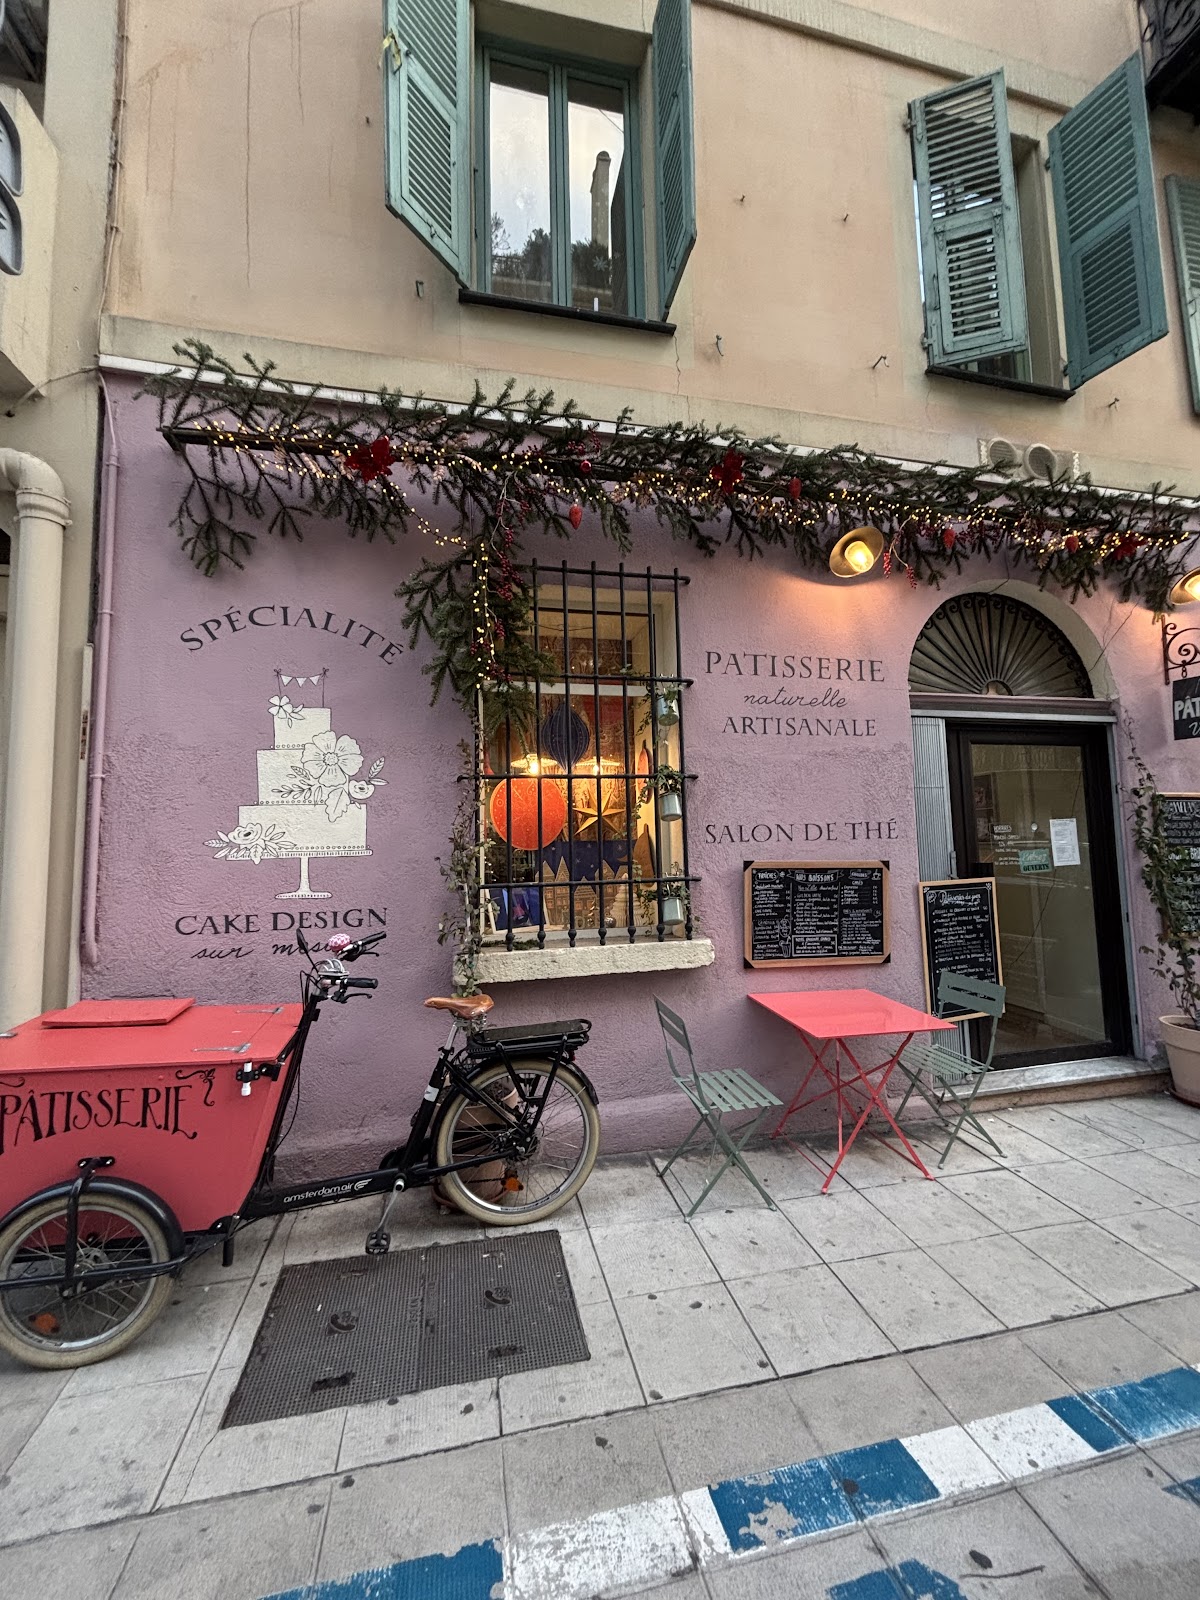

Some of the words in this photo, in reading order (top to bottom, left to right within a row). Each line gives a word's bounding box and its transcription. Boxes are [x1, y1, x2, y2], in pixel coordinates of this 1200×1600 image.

[180, 604, 404, 665] SPÉCIALITÉ
[705, 651, 885, 682] PATISSERIE
[744, 686, 848, 708] naturelle
[722, 716, 877, 737] ARTISANALE
[705, 823, 795, 844] SALON
[804, 822, 838, 841] DE
[845, 818, 899, 840] THÉ
[808, 873, 834, 882] BOISSONS
[1023, 863, 1050, 872] OUVERTS
[175, 914, 260, 936] CAKE
[271, 907, 387, 931] DESIGN
[191, 945, 254, 959] sur
[0, 1085, 197, 1157] PÂTISSERIE
[283, 1186, 341, 1203] amsterdam
[341, 1182, 354, 1190] air
